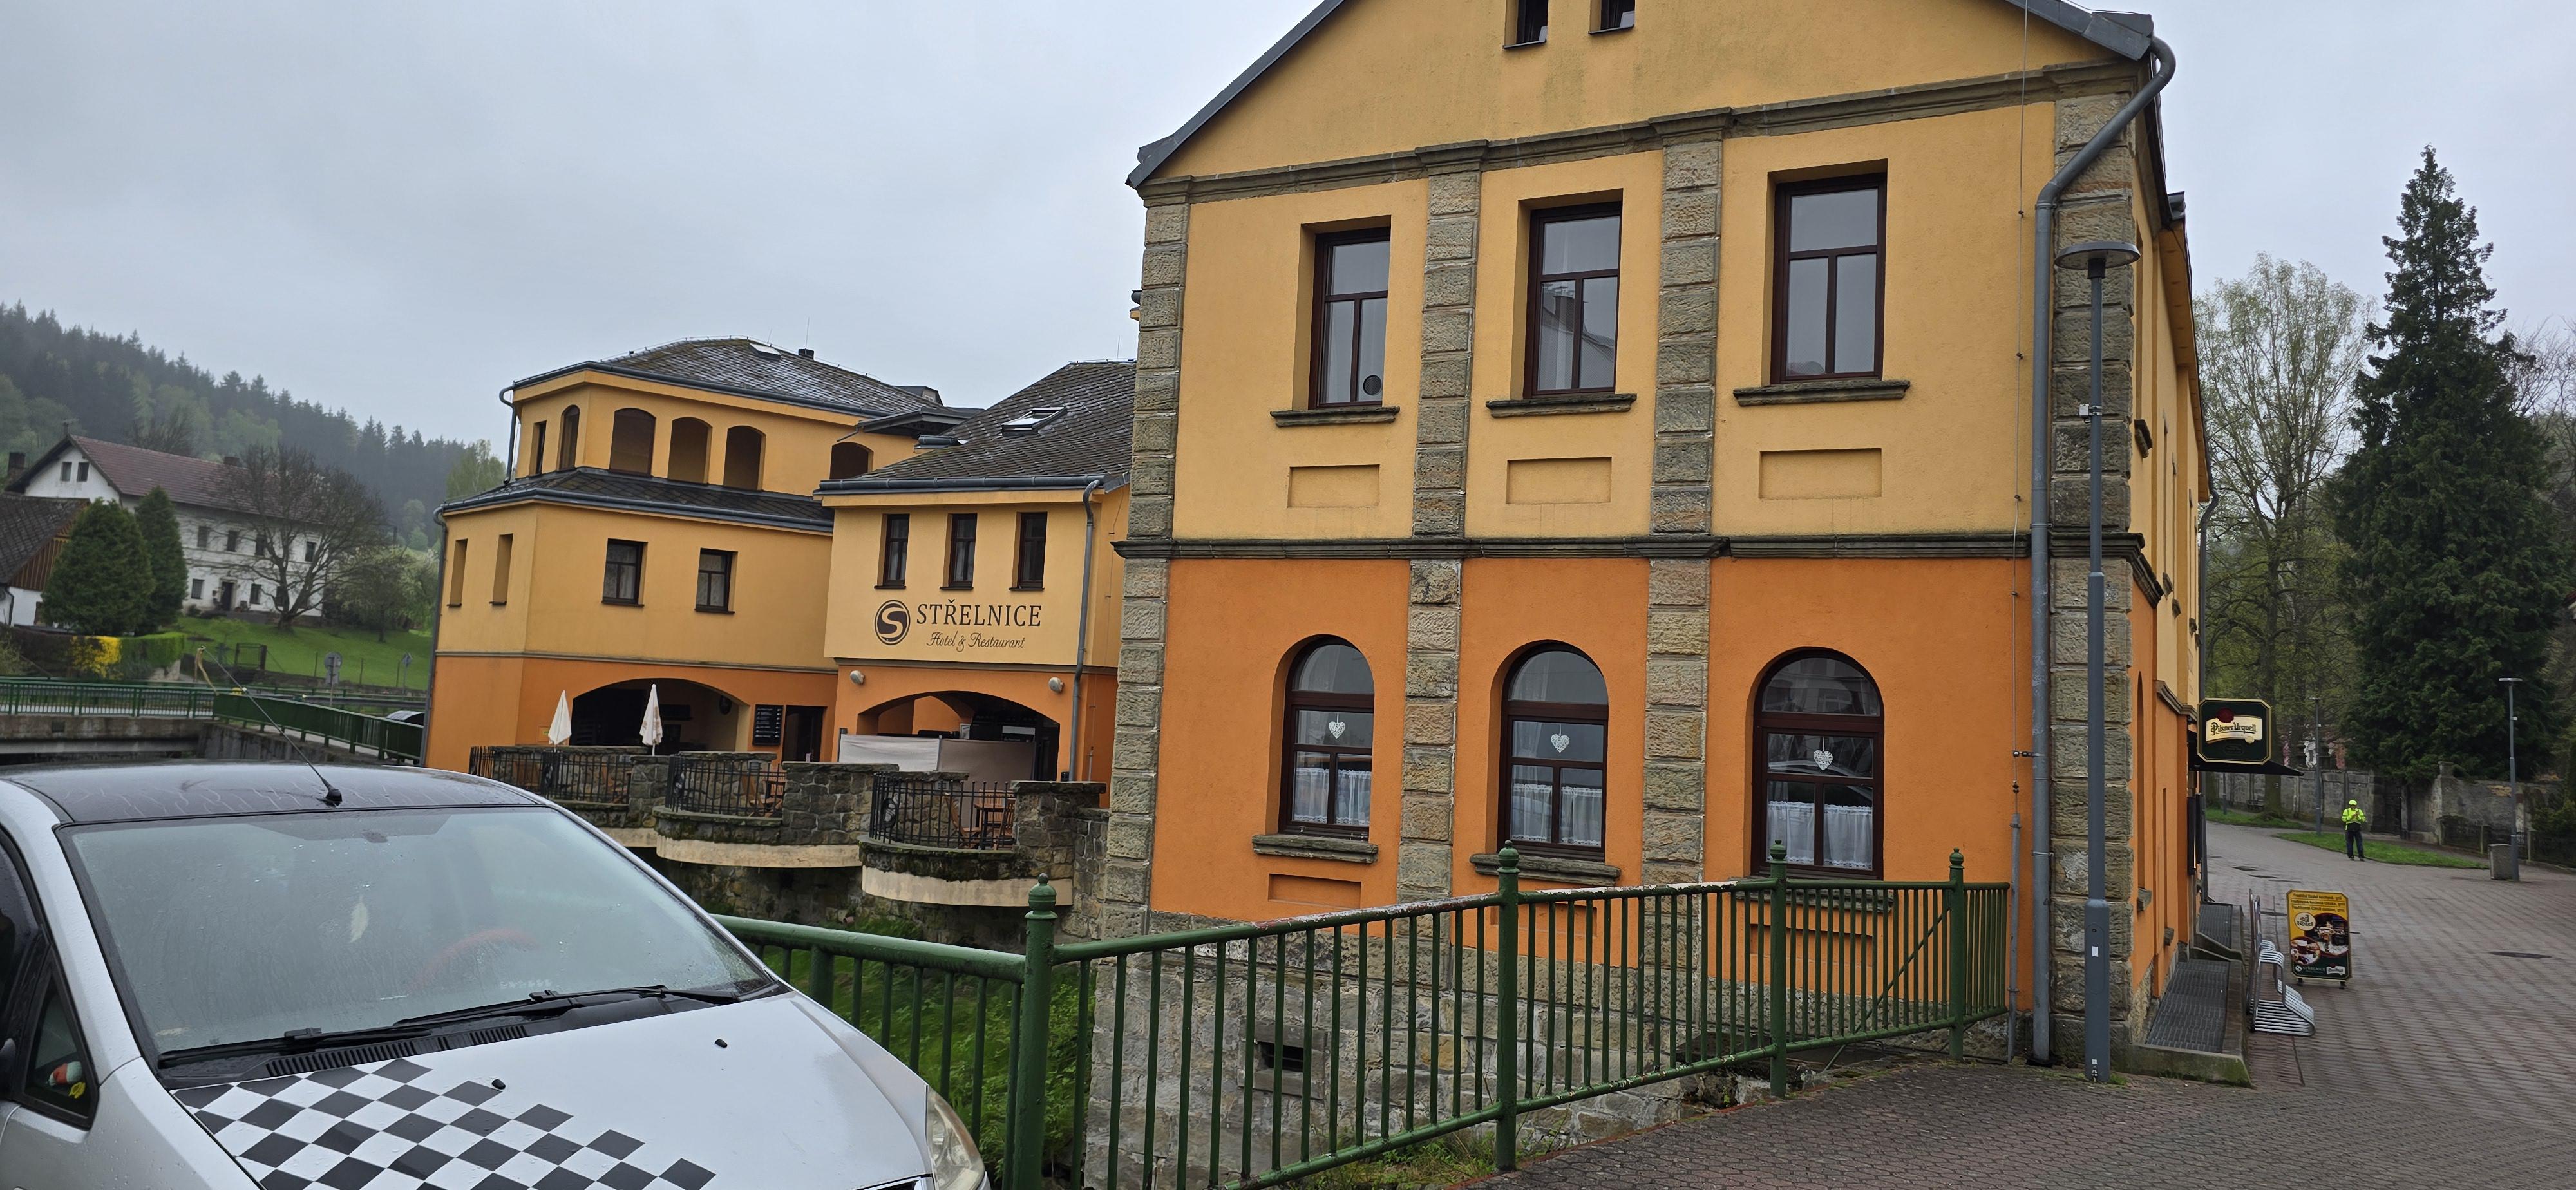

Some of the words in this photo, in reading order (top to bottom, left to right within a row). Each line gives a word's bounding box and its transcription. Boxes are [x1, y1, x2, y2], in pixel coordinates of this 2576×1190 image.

[916, 598, 1041, 627] STŘELNICE
[927, 630, 958, 647] Hotel
[956, 636, 965, 652] &
[967, 632, 1025, 648] Restaurant
[2211, 722, 2234, 735] Pilsner
[2233, 721, 2256, 734] Urquell
